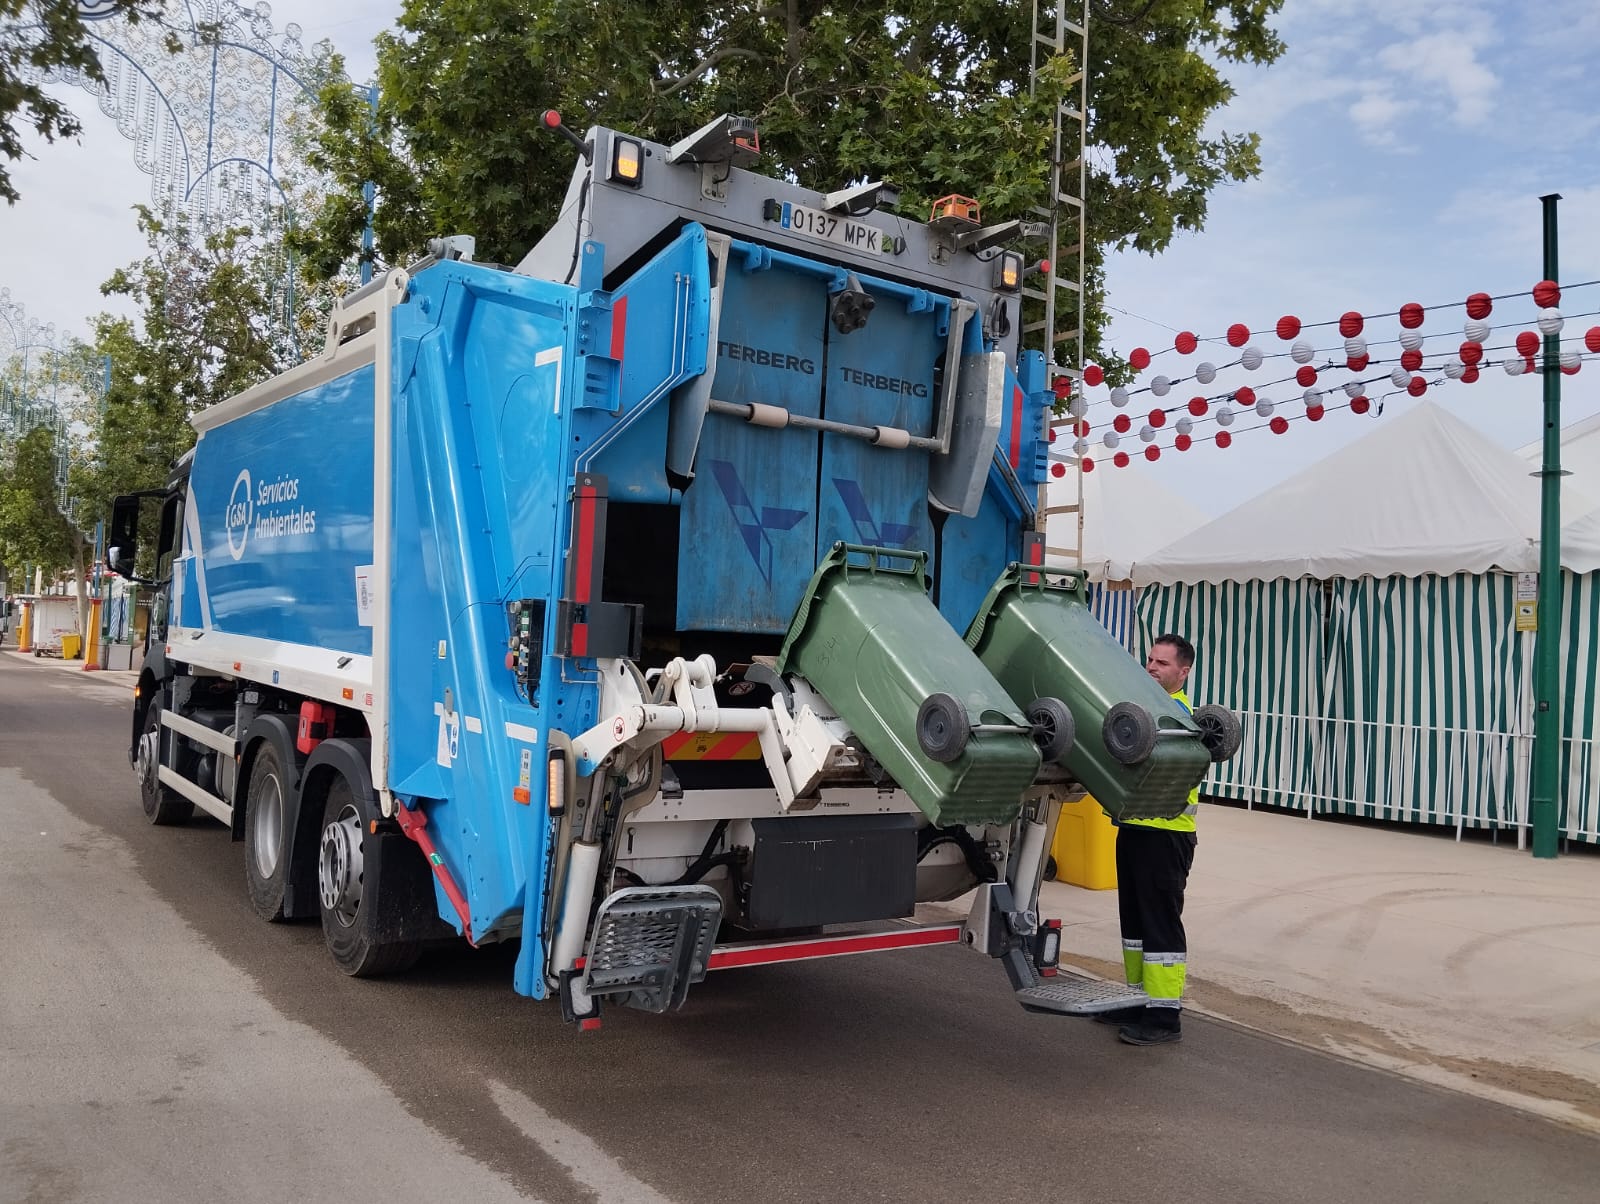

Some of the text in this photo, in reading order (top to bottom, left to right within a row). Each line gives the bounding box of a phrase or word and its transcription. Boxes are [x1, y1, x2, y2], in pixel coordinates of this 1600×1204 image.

[793, 209, 877, 251] 0137 MPK
[717, 341, 814, 375] TERBERG
[840, 366, 928, 398] TERBERG
[256, 473, 299, 506] Servicios
[230, 501, 246, 528] GSA
[255, 505, 316, 539] Ambientales
